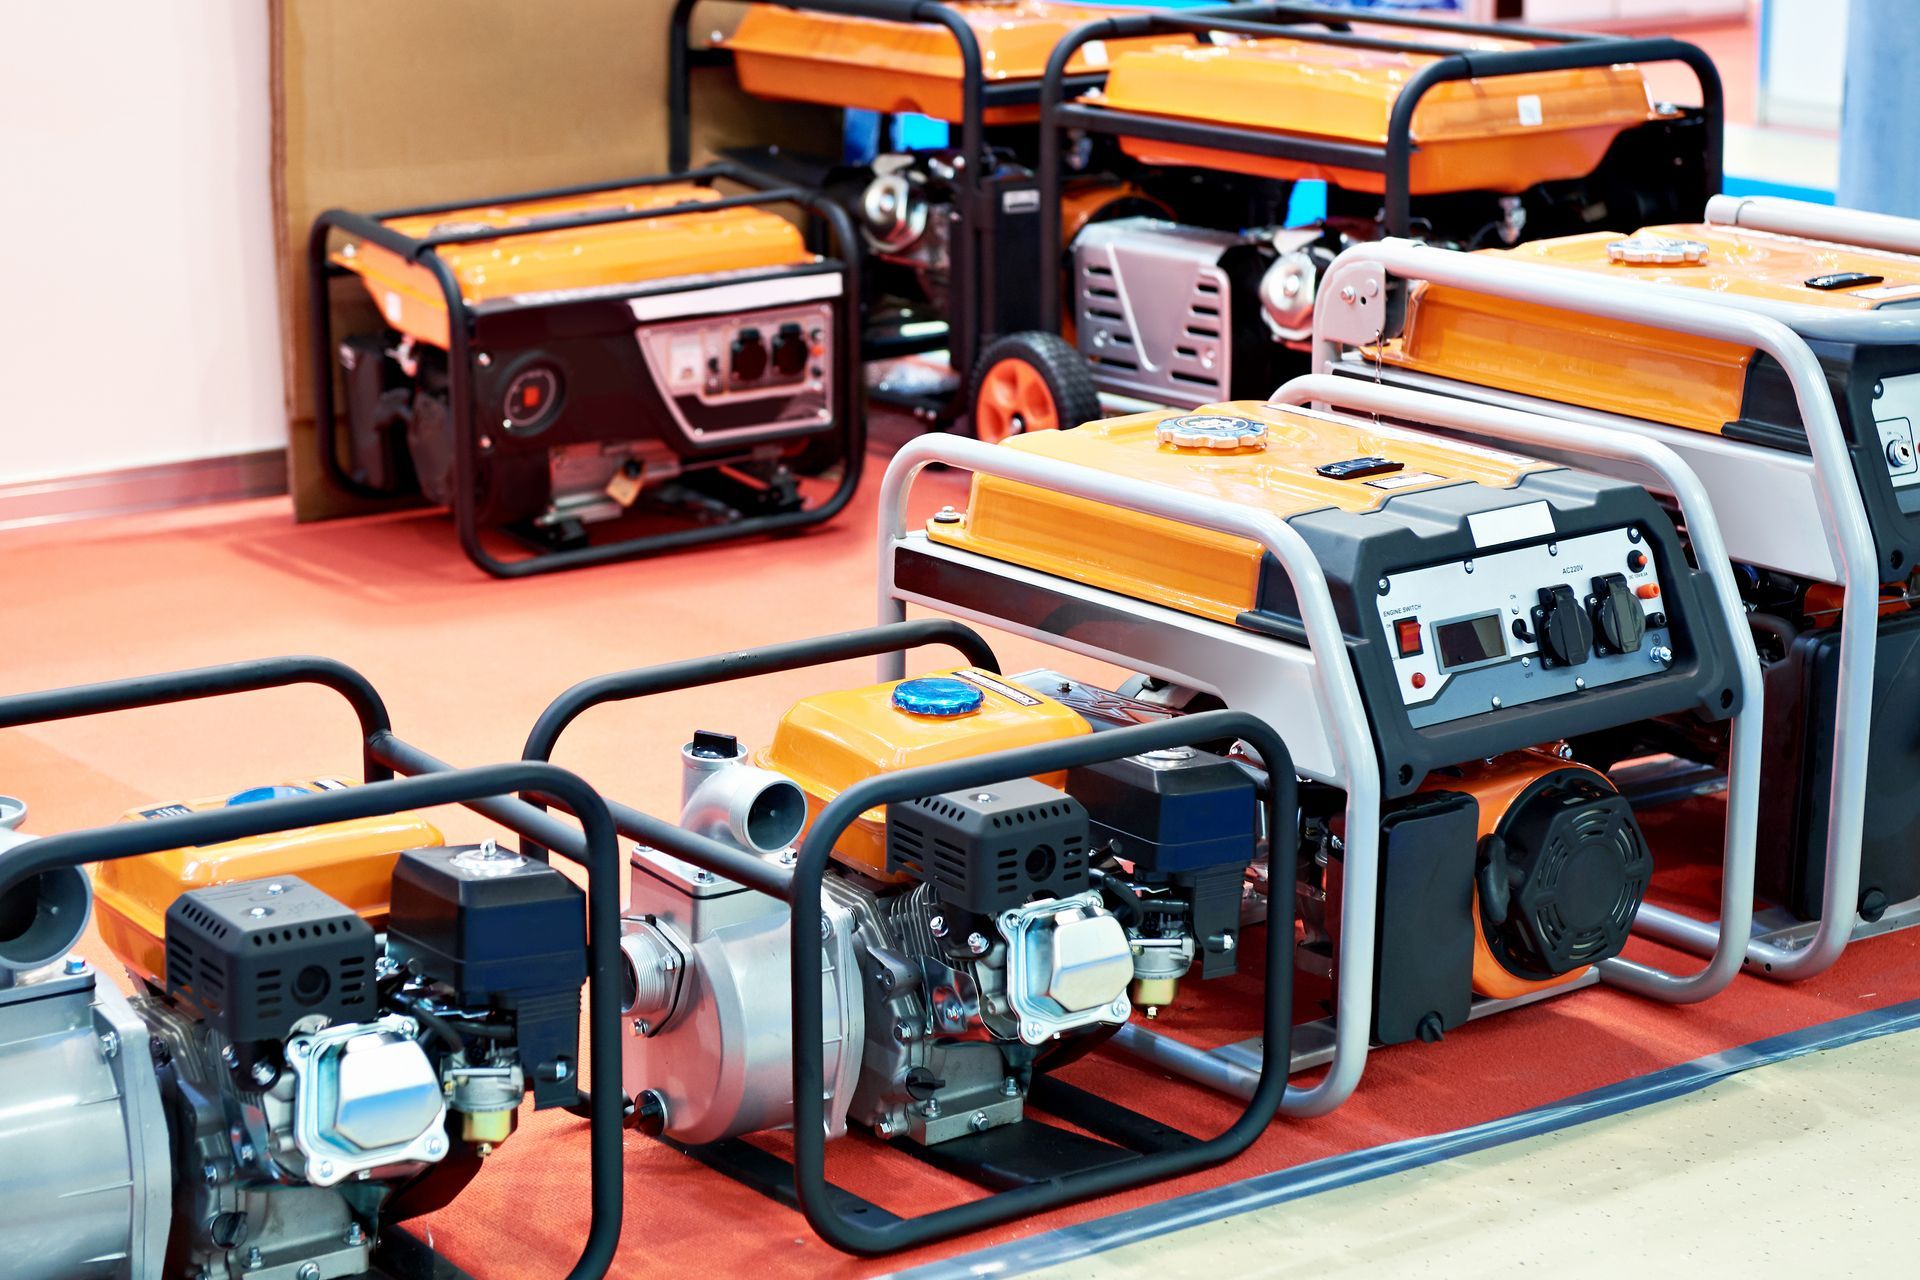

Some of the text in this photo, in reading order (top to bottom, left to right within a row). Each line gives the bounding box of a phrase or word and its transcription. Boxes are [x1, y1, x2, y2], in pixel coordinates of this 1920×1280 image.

[1562, 565, 1583, 574] AC220V
[1383, 604, 1421, 617] ENGINE SWITCH
